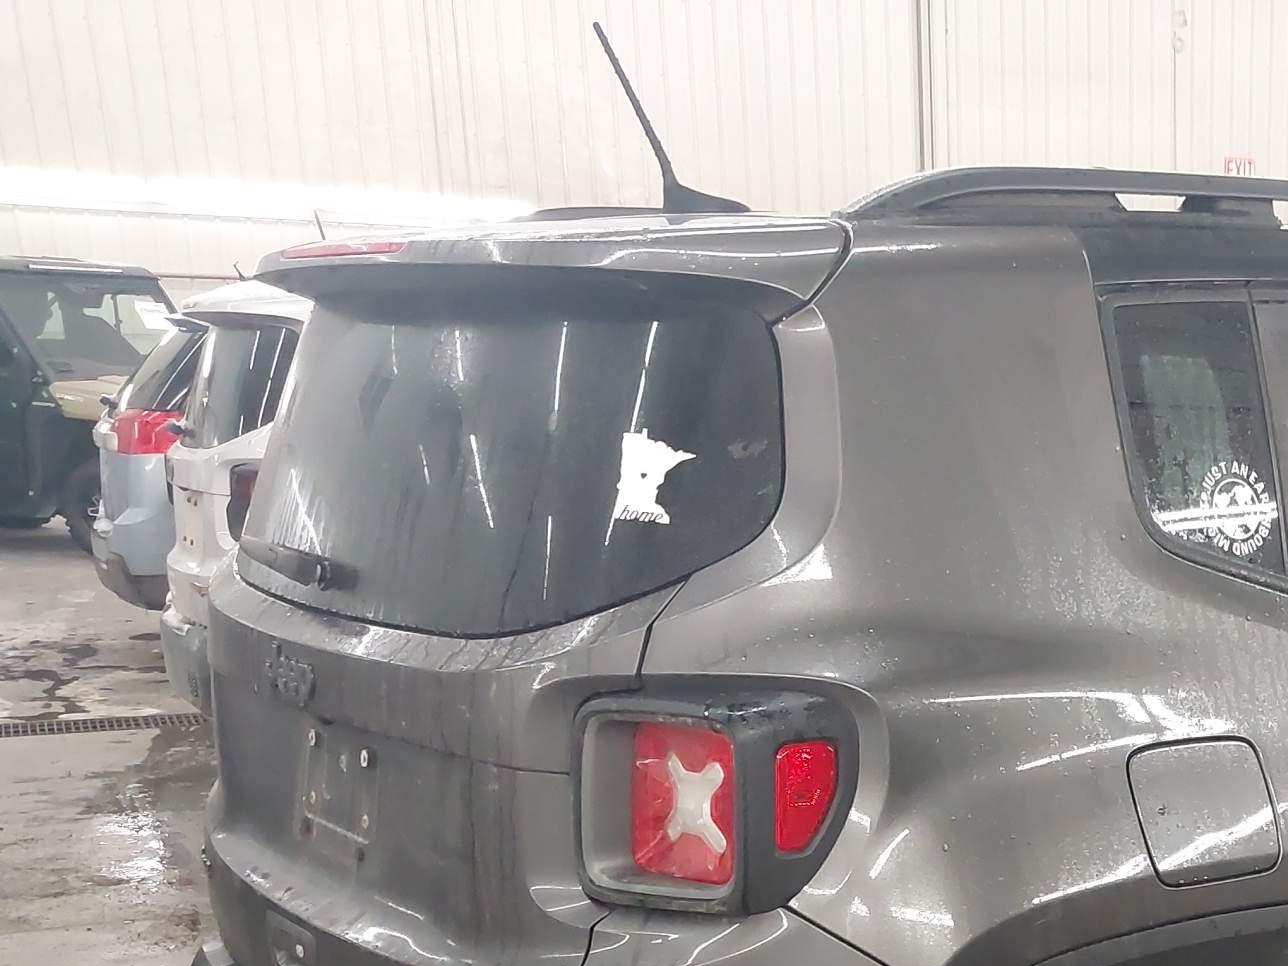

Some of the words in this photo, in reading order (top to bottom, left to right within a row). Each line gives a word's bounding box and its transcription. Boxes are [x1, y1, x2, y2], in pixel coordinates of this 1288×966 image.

[1202, 461, 1227, 494] JUST
[1231, 460, 1249, 479] AN
[619, 504, 664, 522] home
